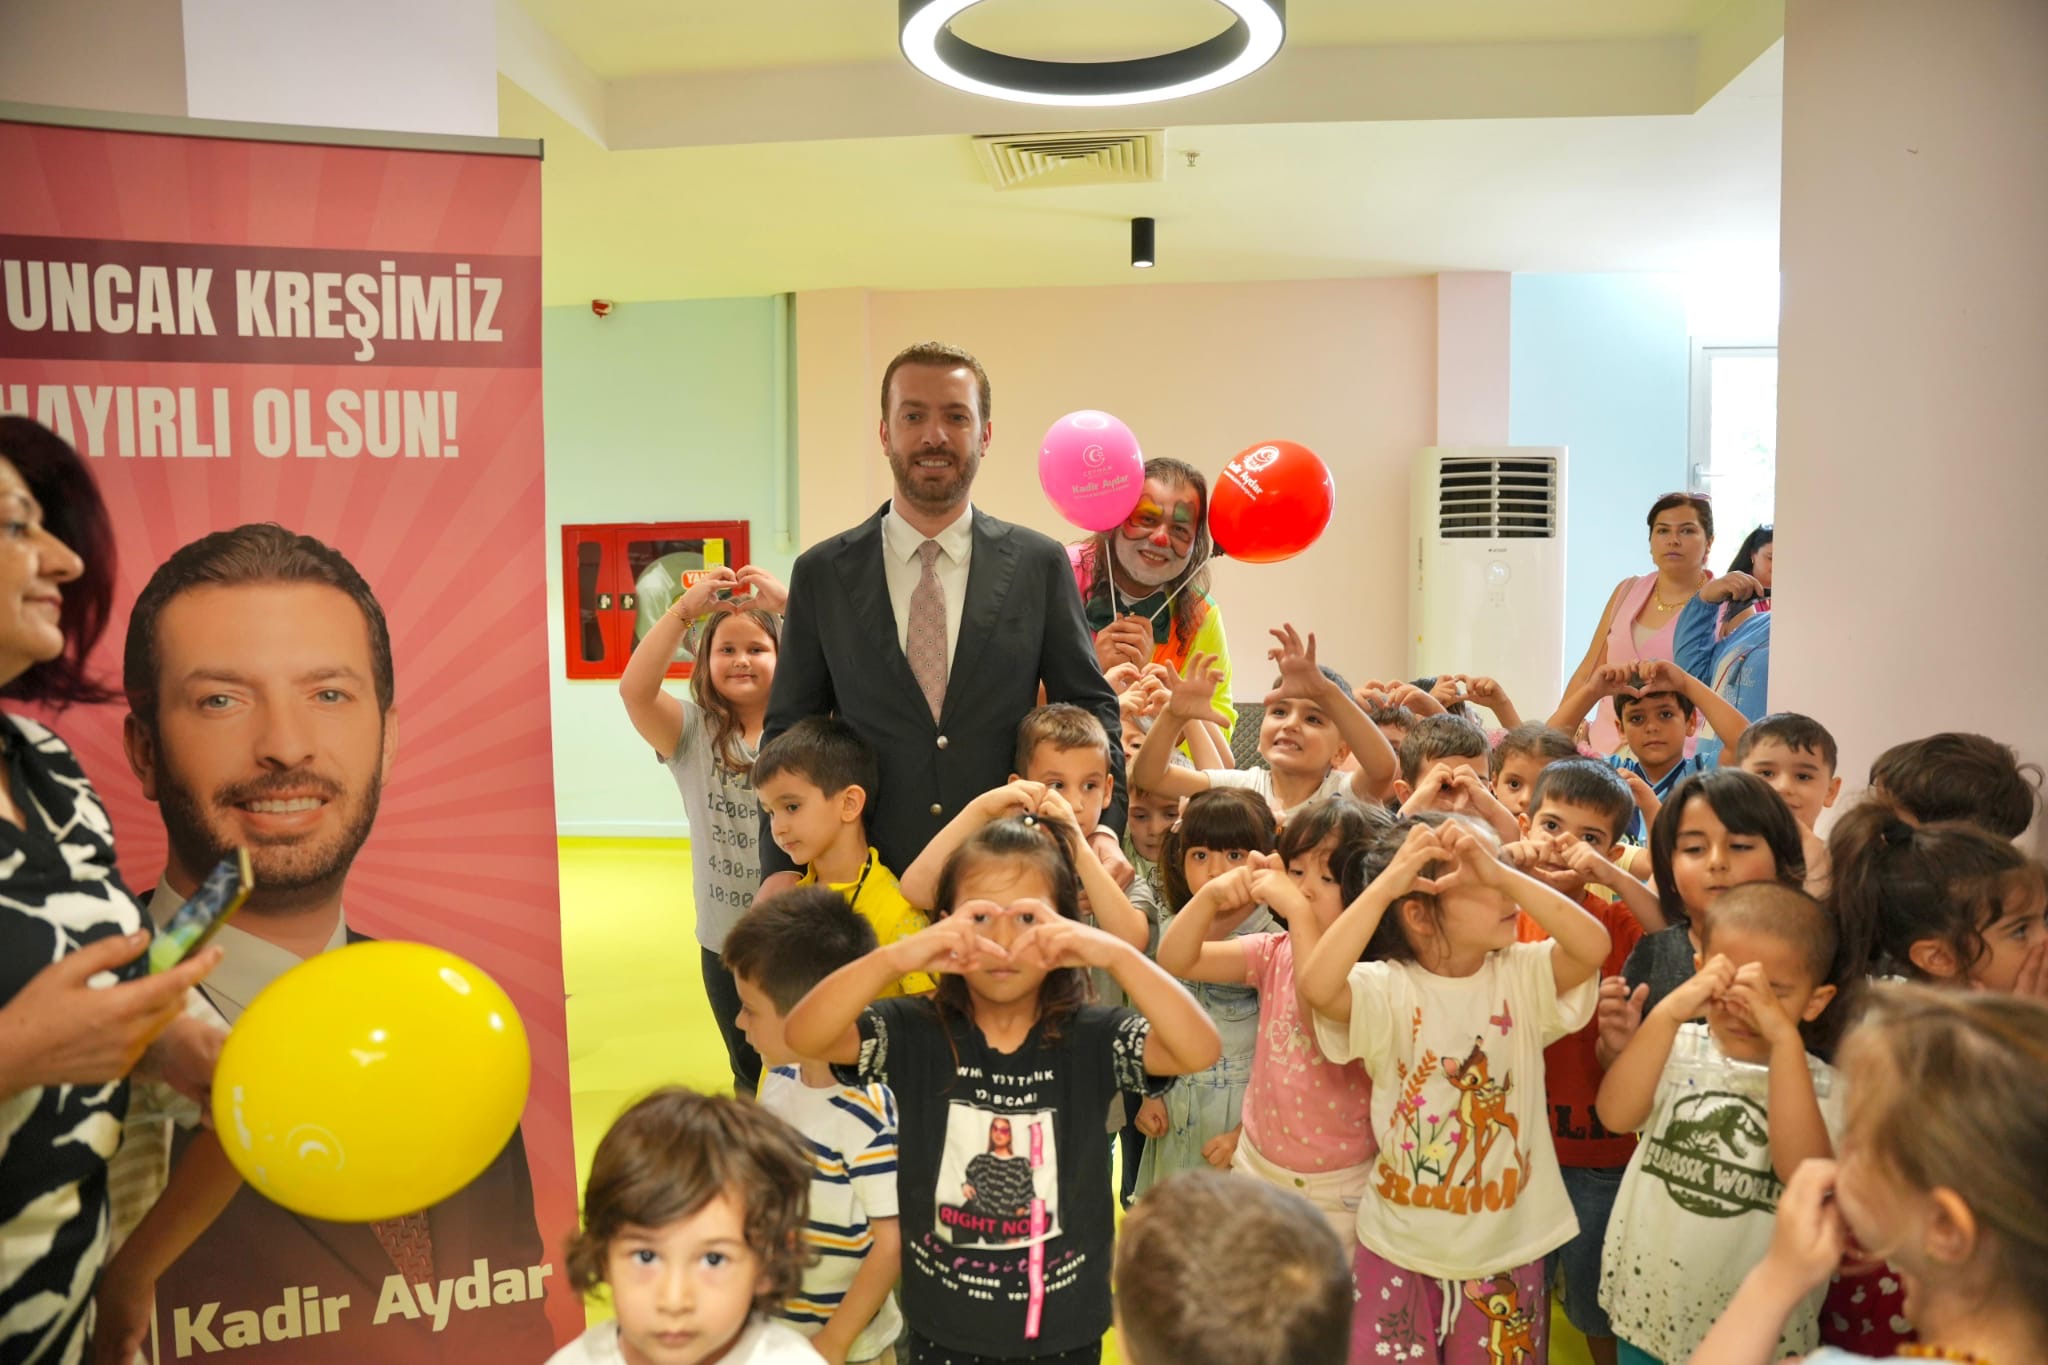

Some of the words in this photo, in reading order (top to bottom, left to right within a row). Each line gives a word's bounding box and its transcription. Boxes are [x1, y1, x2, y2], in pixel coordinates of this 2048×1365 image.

[0, 260, 218, 336] UNCAK
[235, 260, 503, 362] KREŞİMİZ
[253, 388, 459, 458] OLSUN!
[1642, 1142, 1710, 1185] JURASSIC
[940, 1206, 997, 1234] RIGHT
[1002, 1217, 1049, 1236] NO
[173, 1286, 350, 1358] Kadir
[372, 1258, 553, 1332] Aydar
